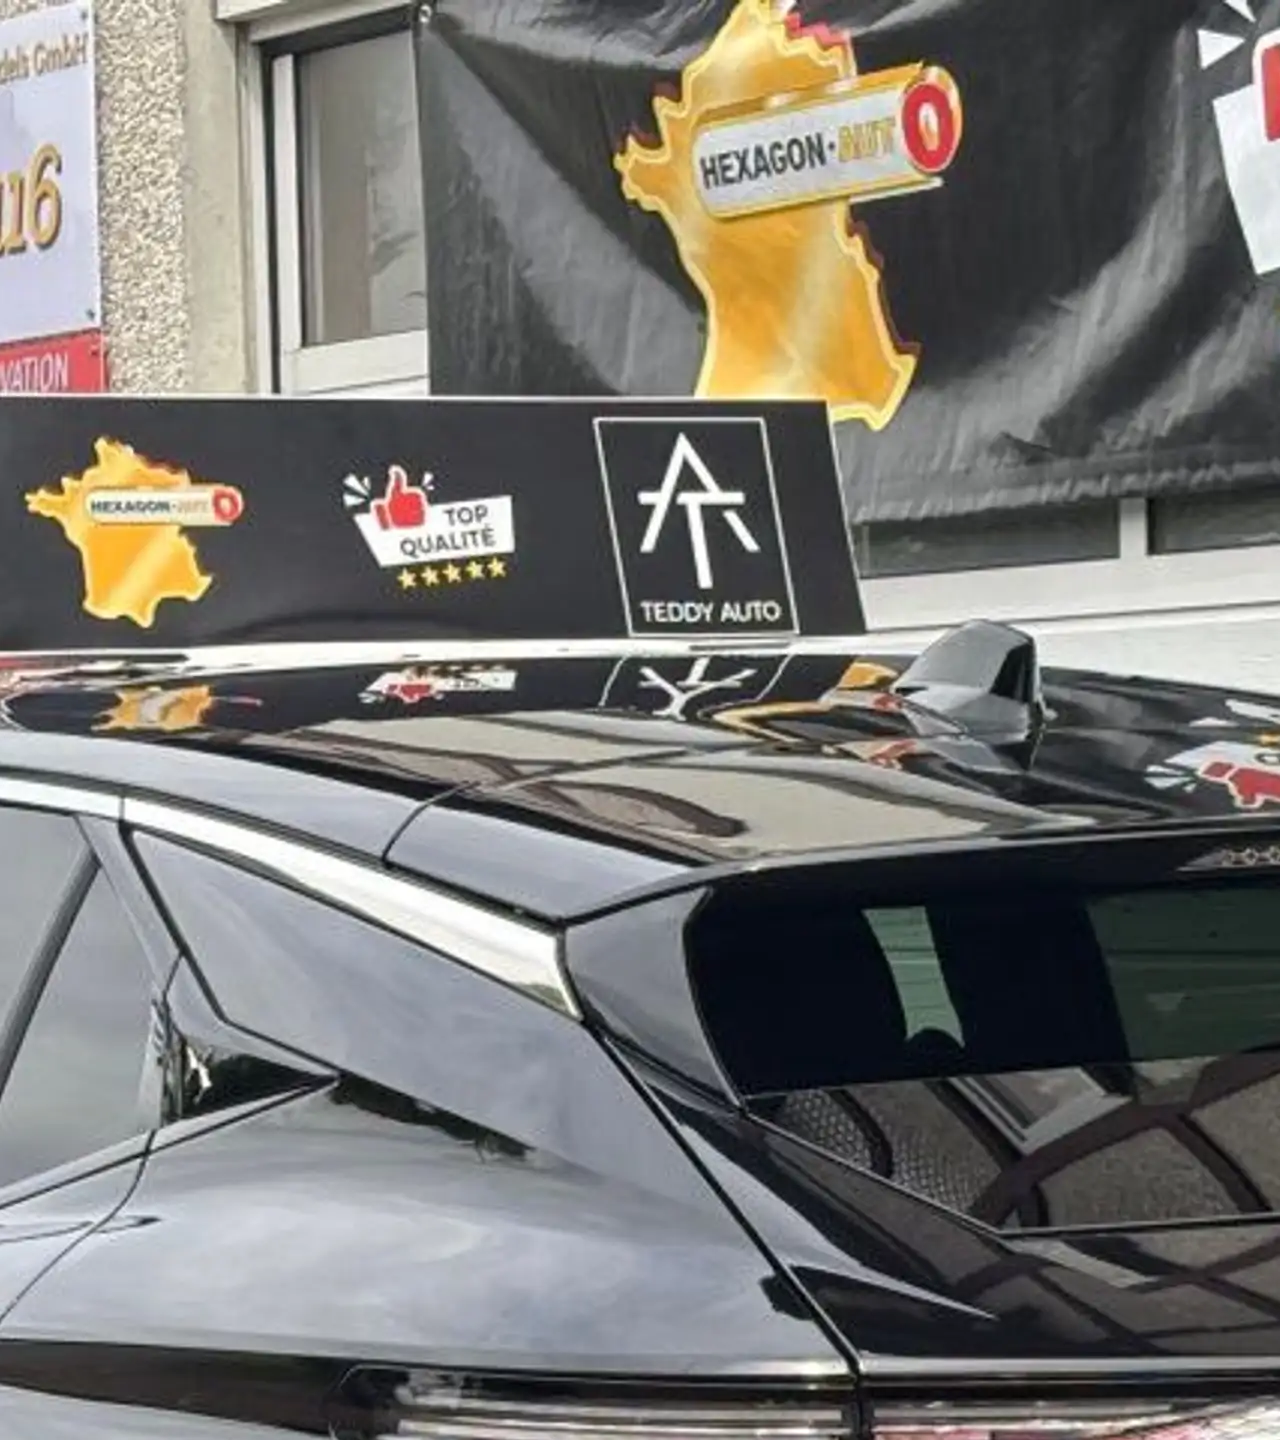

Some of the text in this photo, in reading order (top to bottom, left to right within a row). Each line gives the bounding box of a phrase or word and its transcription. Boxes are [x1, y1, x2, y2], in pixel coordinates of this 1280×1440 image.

[34, 31, 90, 77] GmbH
[442, 504, 489, 526] TOP
[400, 523, 497, 560] QUALITÉ
[640, 600, 783, 623] TEDDY AUTO
